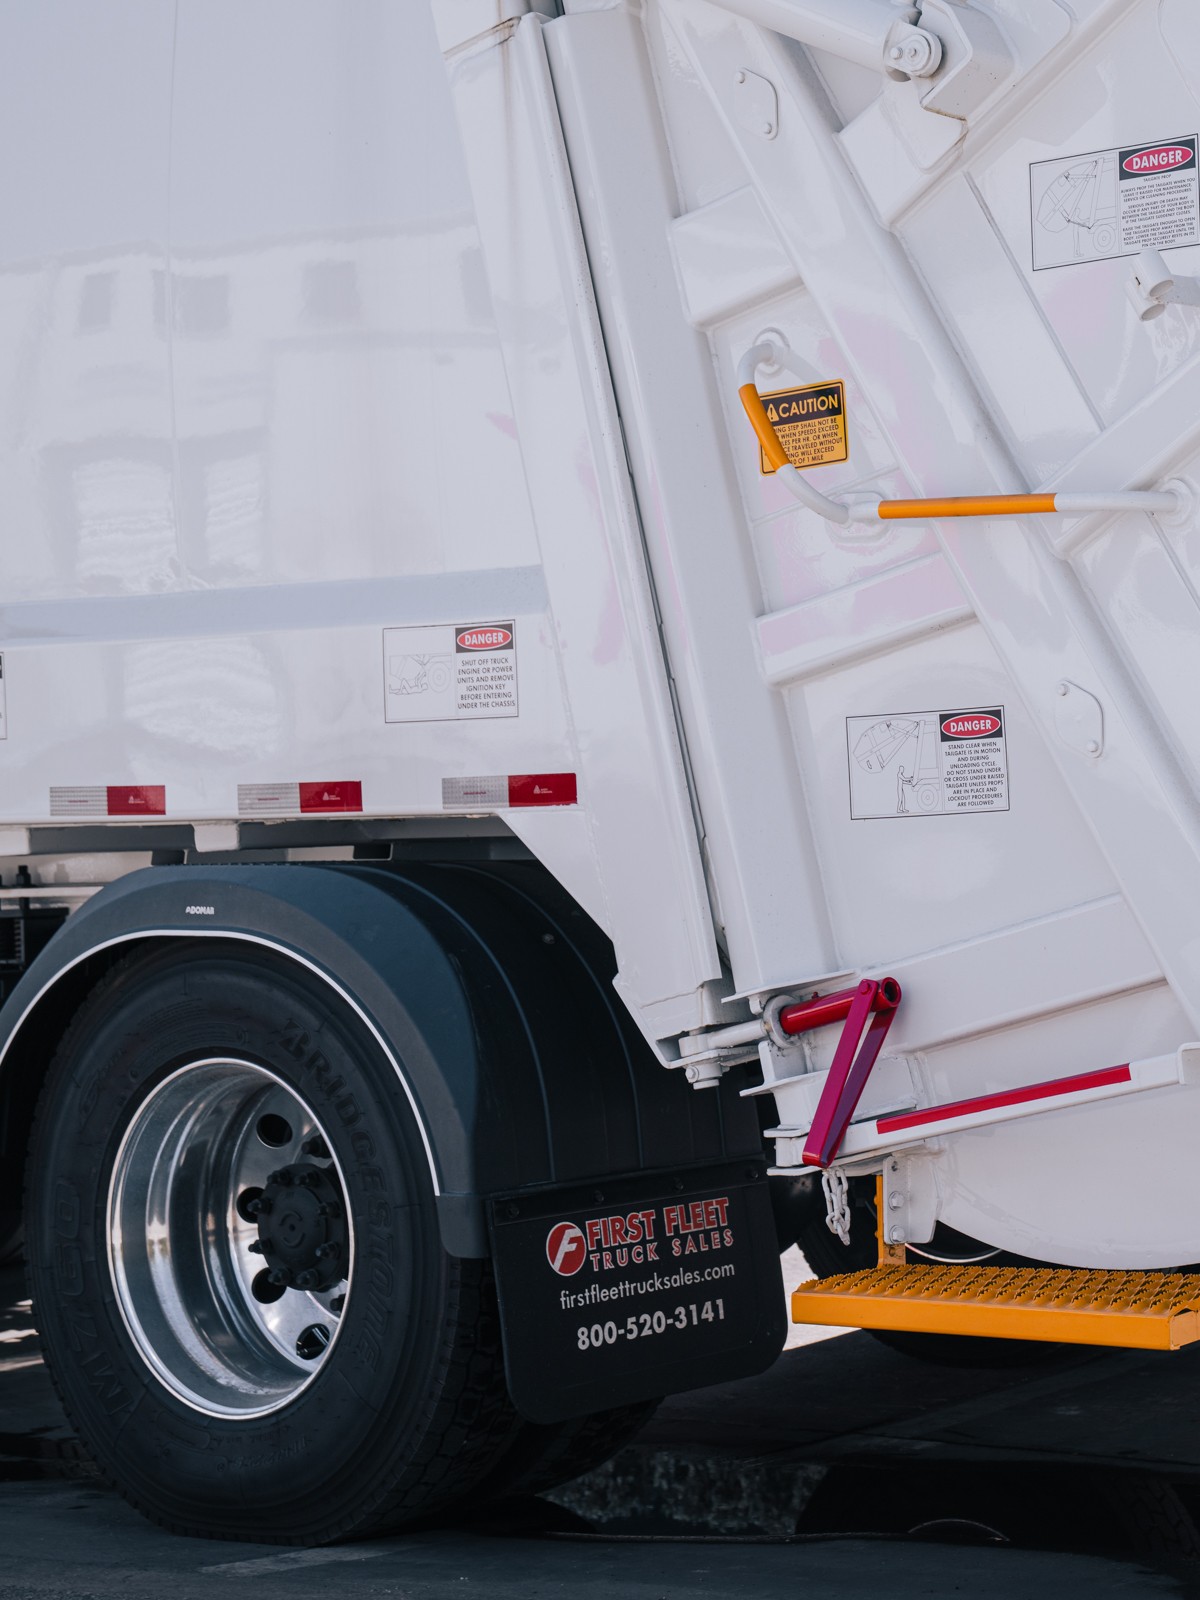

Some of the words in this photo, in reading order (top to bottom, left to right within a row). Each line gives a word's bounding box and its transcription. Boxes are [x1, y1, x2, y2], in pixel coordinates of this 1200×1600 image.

[1132, 150, 1182, 169] DANGER
[779, 394, 838, 417] CAUTION
[818, 424, 839, 432] EXCEED
[792, 442, 817, 451] TRAVELED
[819, 437, 842, 446] WITHOUT
[814, 446, 834, 454] EXCEED
[465, 632, 503, 645] DANGER
[950, 720, 992, 732] DANGER
[279, 1017, 394, 1372] BRIDGESTONE
[585, 1209, 656, 1250] FIRST
[663, 1197, 729, 1236] FLEET
[590, 1242, 660, 1272] TRUCK
[672, 1229, 734, 1256] SALES
[560, 1264, 735, 1310] firstfleettrucksales.com
[577, 1299, 725, 1351] 800-520-3141
